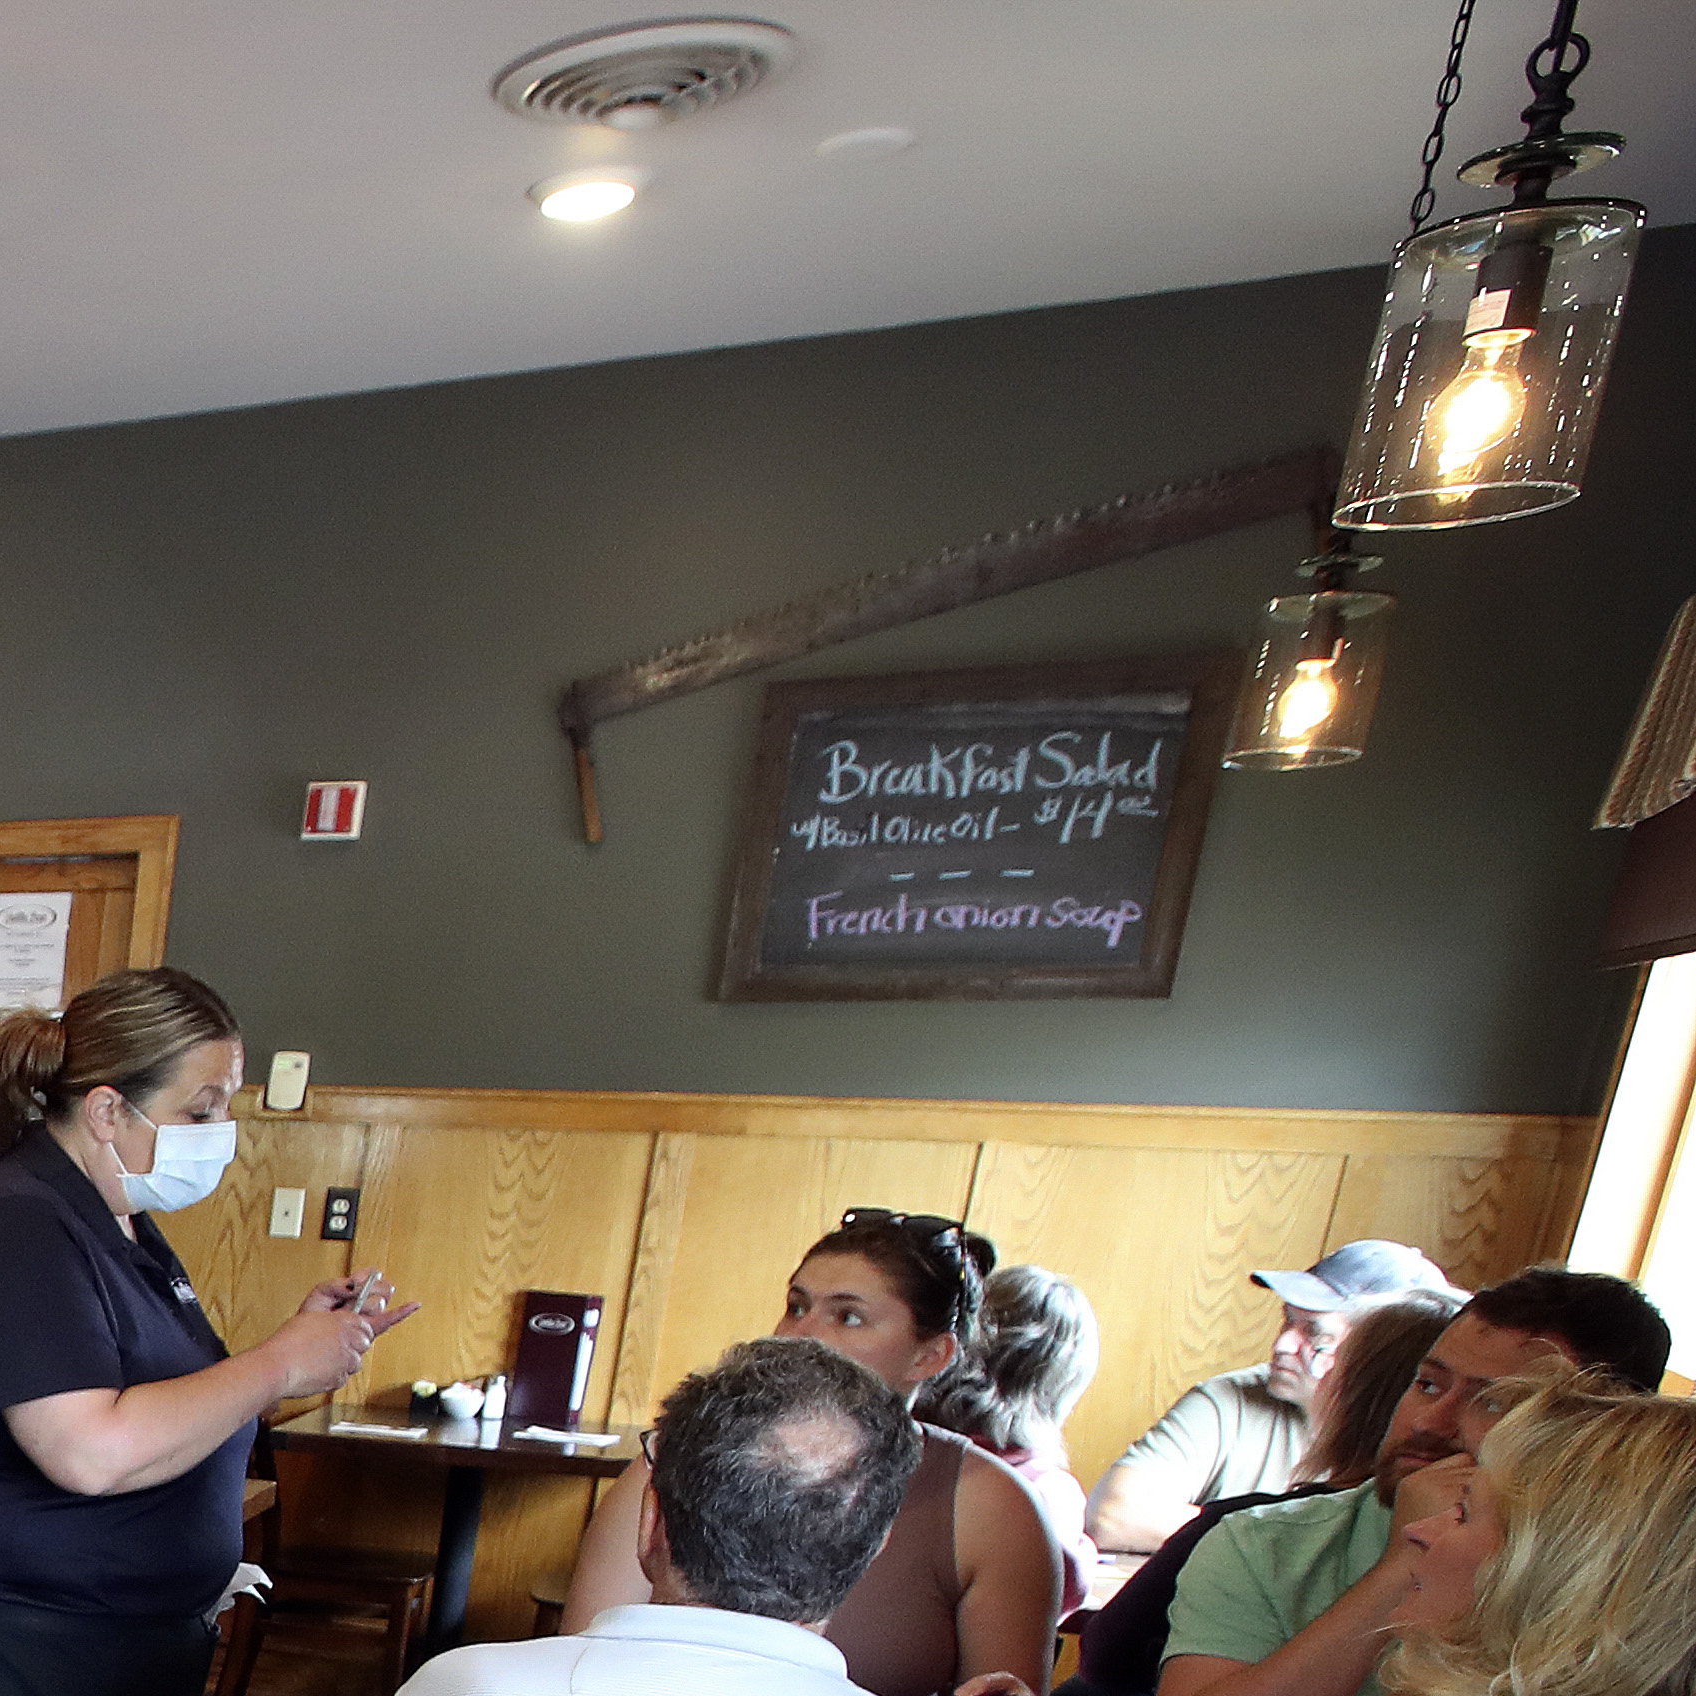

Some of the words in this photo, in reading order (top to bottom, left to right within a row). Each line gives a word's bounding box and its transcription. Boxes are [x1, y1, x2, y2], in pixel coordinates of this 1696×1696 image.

[1034, 731, 1163, 791] Salad
[807, 890, 929, 941] French
[1045, 896, 1144, 949] Soup
